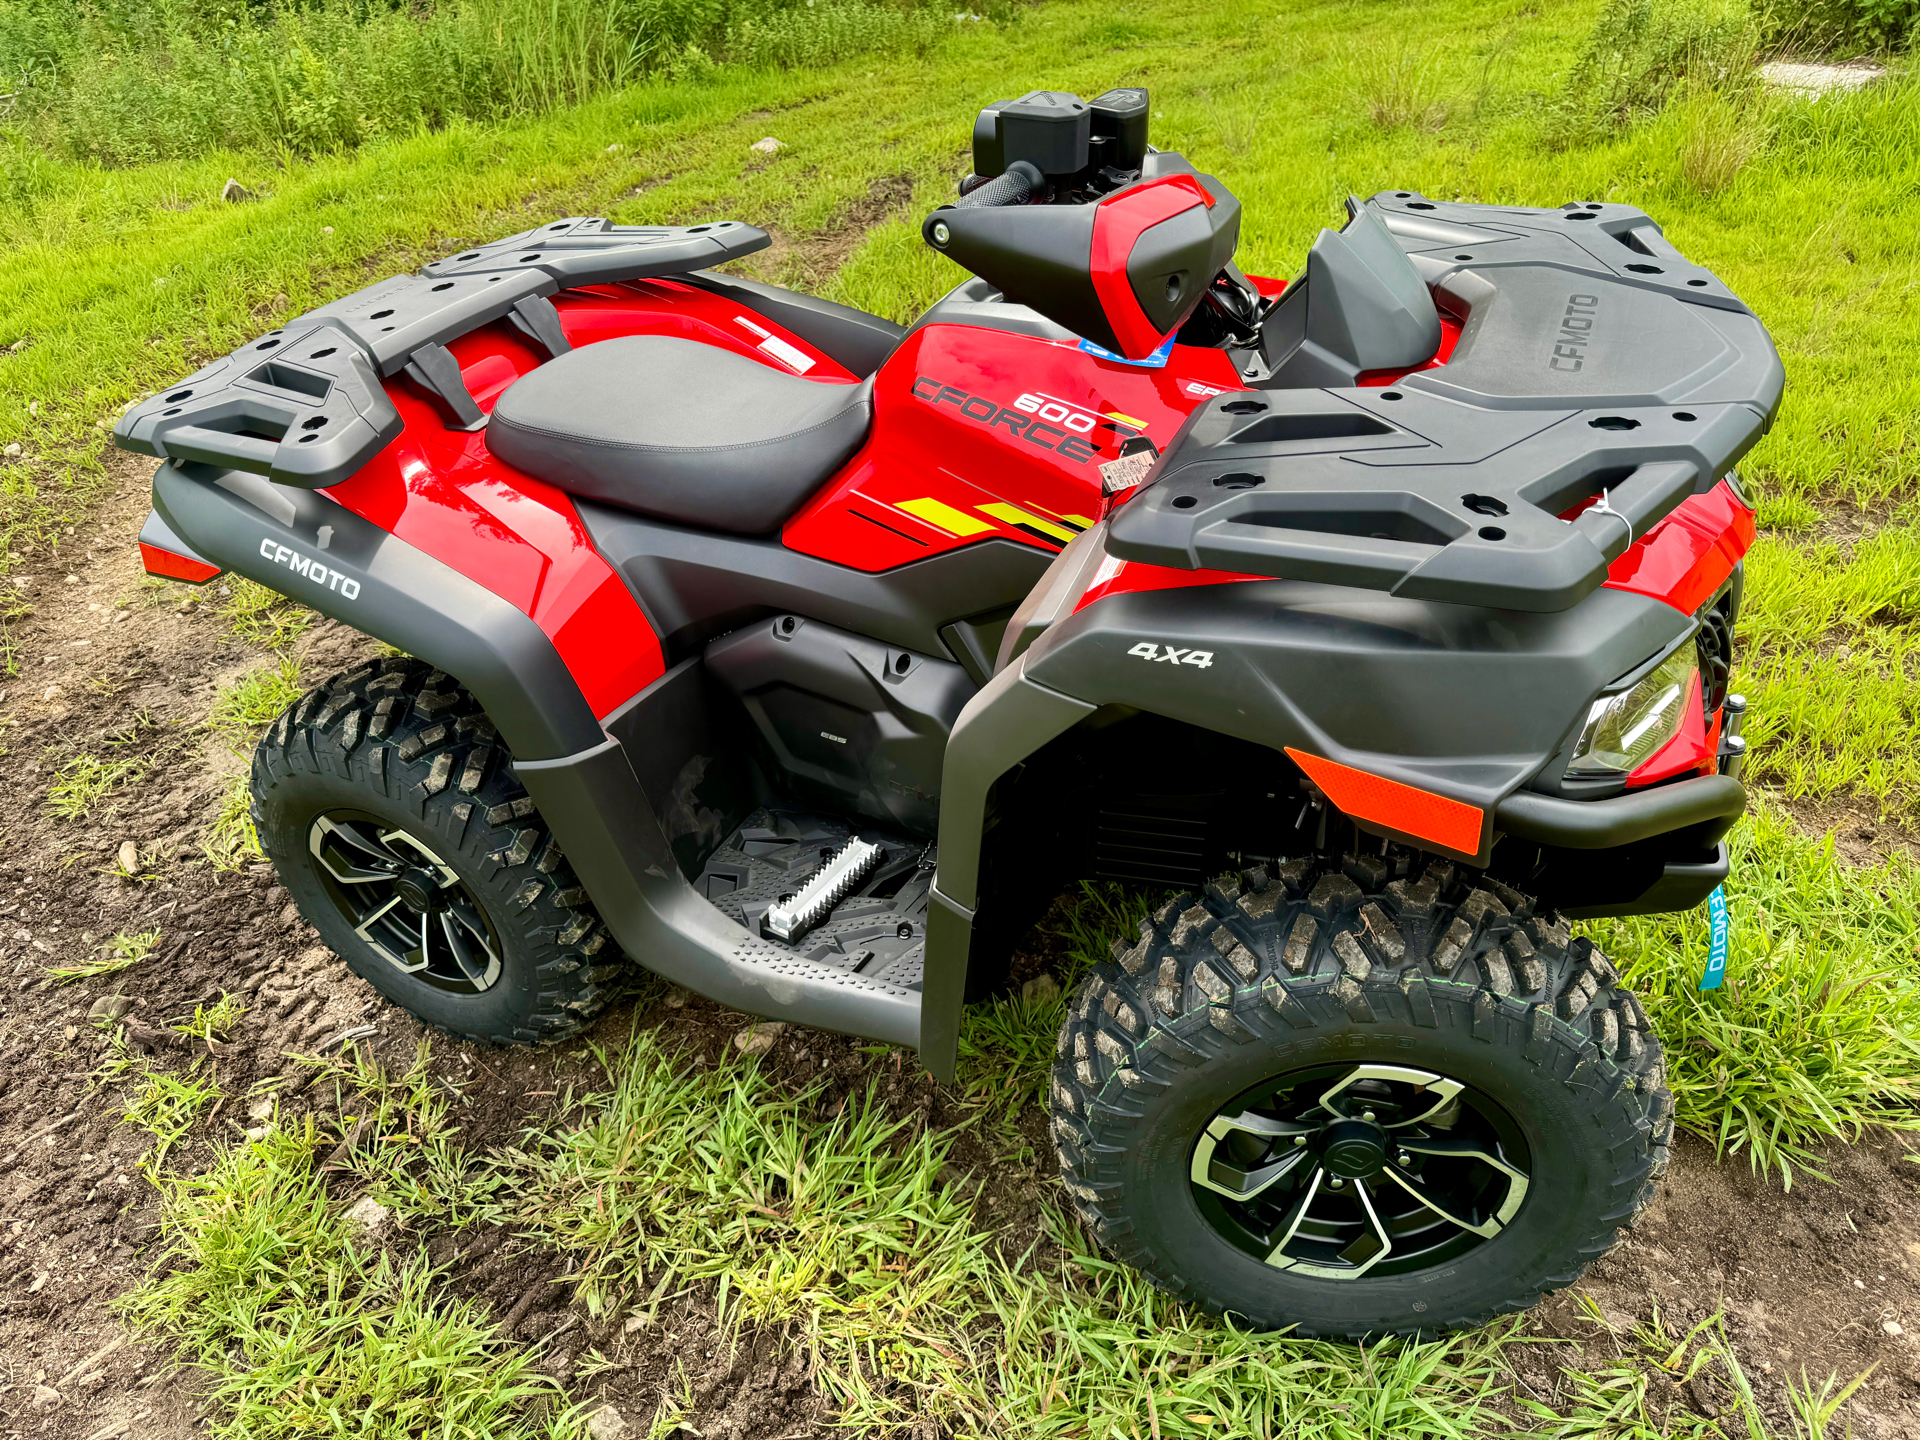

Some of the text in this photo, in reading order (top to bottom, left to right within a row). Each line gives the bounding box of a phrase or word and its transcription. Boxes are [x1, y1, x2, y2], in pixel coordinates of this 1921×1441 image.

[1548, 293, 1599, 373] CFMOTO
[911, 376, 1102, 464] CFORCE
[1013, 392, 1097, 433] 600
[259, 538, 361, 601] CFMOTO
[1126, 642, 1214, 669] 4X4
[1271, 1033, 1417, 1058] CFMOTO
